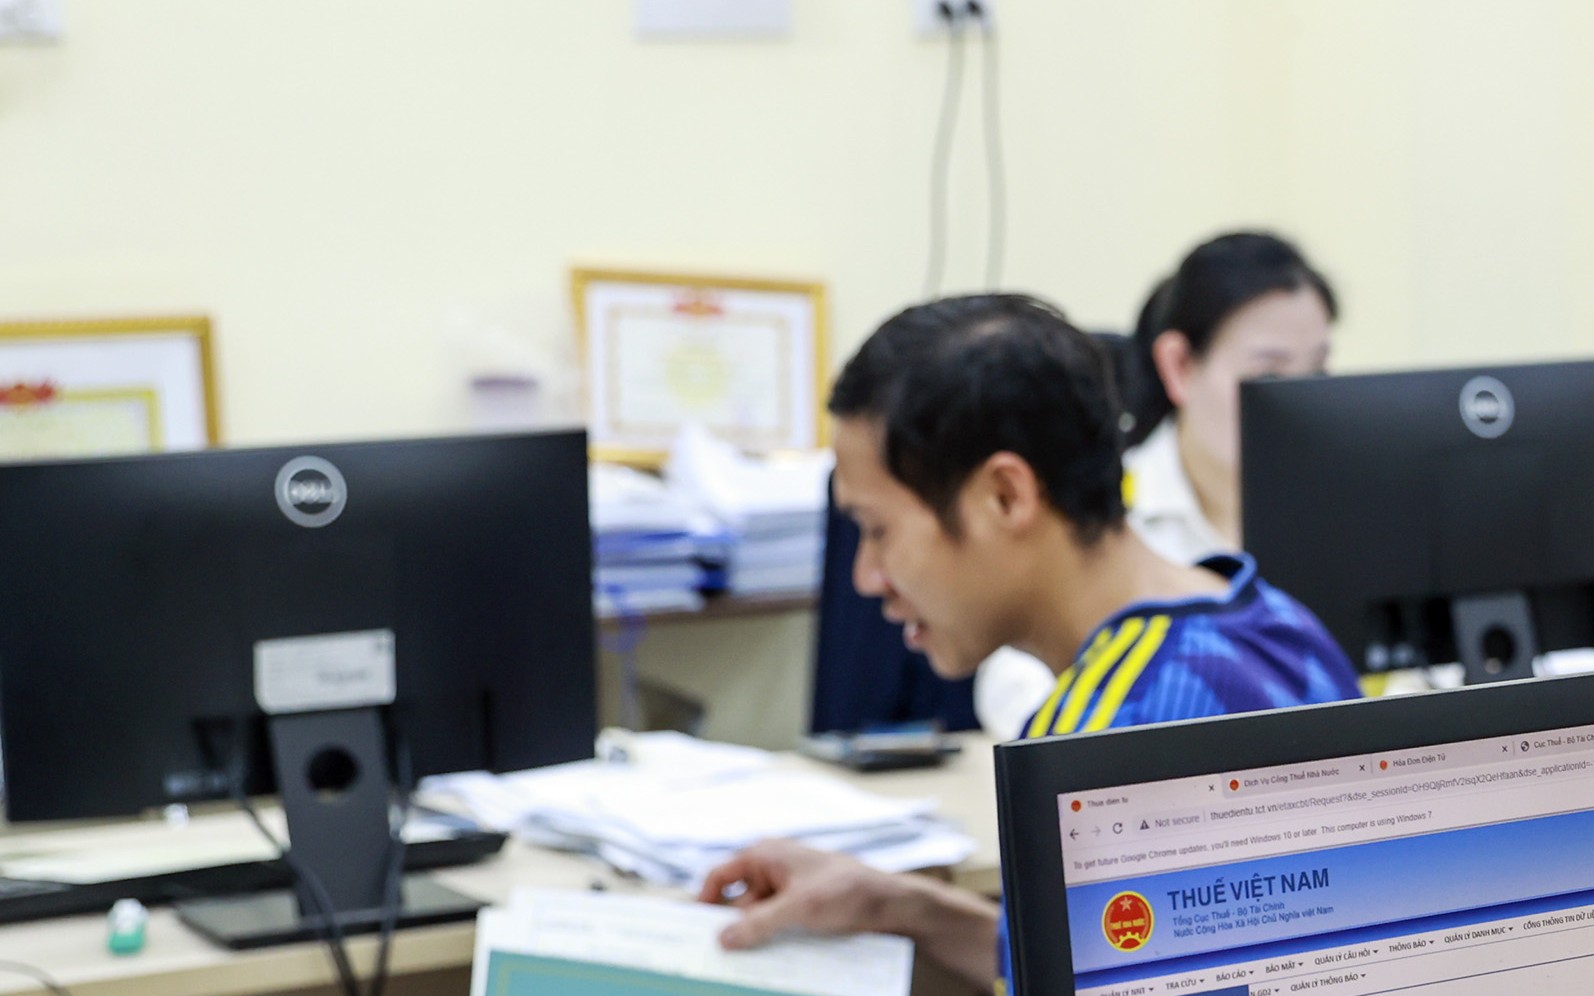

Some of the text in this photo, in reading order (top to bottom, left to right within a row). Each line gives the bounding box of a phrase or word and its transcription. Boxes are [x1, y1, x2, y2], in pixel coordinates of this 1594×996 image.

[1154, 814, 1200, 829] Not secure
[1073, 860, 1082, 870] To
[1083, 858, 1096, 870] get
[1097, 855, 1118, 867] future
[1119, 850, 1147, 865] Google
[1147, 846, 1177, 859] Chrome
[1229, 836, 1248, 848] need
[1248, 831, 1281, 845] Windows
[1282, 830, 1292, 840] 10
[1293, 830, 1301, 838] or
[1320, 823, 1336, 834] This
[1336, 819, 1368, 834] computer
[1369, 818, 1375, 827] is
[1376, 815, 1395, 828] using
[1396, 810, 1426, 823] Windows
[1166, 866, 1330, 912] THUẾ VIỆT NAM
[1172, 913, 1192, 928] Tổng
[1193, 912, 1209, 924] Cục
[1210, 908, 1230, 920] Thuế
[1236, 906, 1247, 917] Bộ
[1249, 904, 1261, 914] Tài
[1262, 900, 1285, 912] Chính
[1173, 926, 1193, 938] Nước
[1195, 922, 1216, 936] Cộng
[1217, 920, 1233, 931] Hòa
[1234, 918, 1245, 928] Xã
[1247, 916, 1257, 927] Hội
[1261, 913, 1277, 924] Chủ
[1277, 909, 1300, 923] Nghĩa
[1315, 904, 1334, 915] Nam
[1388, 937, 1427, 953] THÔNG BÁO
[1165, 976, 1197, 991] TRA CỨU
[1215, 968, 1246, 982] BÁO CÁO
[1290, 971, 1359, 992] QUẢN LÝ THÔNG BÁO
